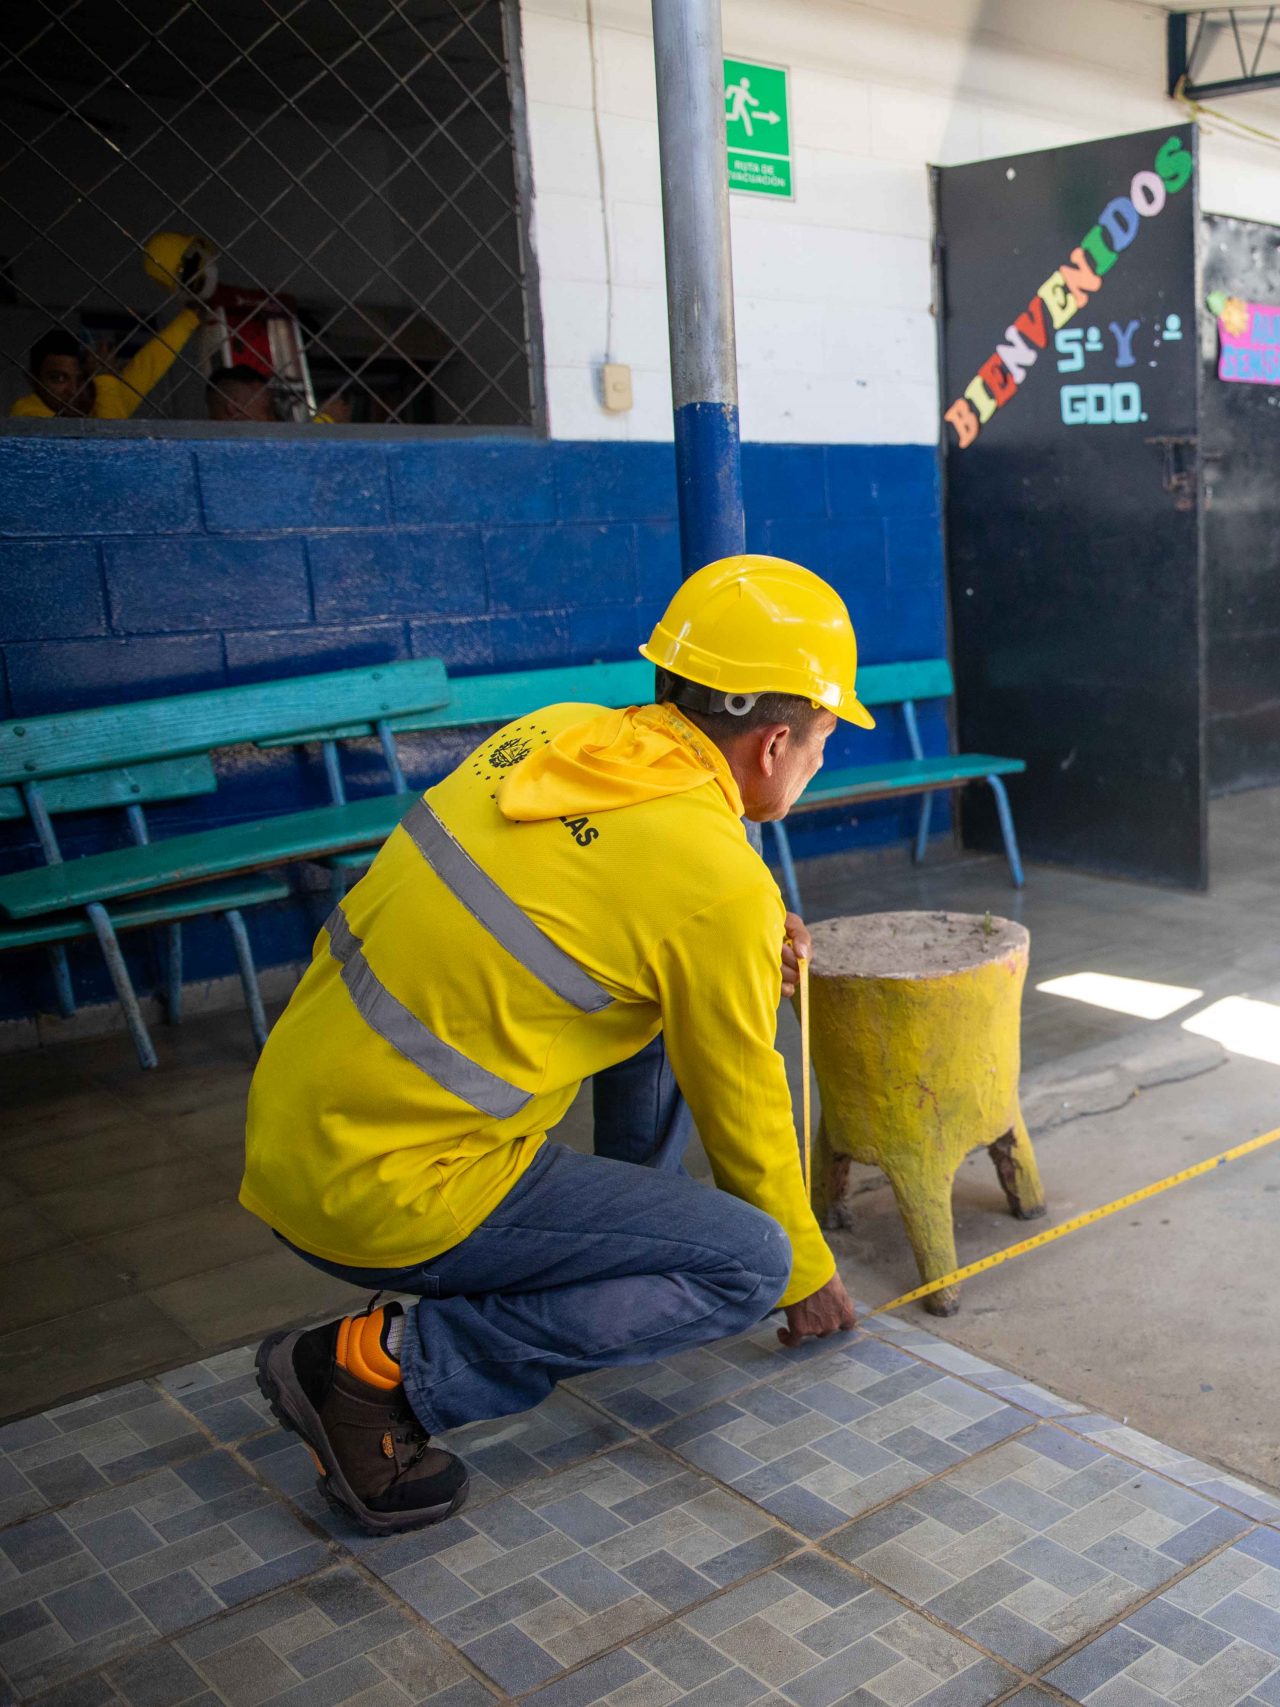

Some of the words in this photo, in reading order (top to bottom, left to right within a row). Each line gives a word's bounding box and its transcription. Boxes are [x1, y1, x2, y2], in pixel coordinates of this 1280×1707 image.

[734, 160, 759, 172] RUTA
[761, 164, 774, 175] DE
[944, 136, 1194, 449] BIENVENIDOS
